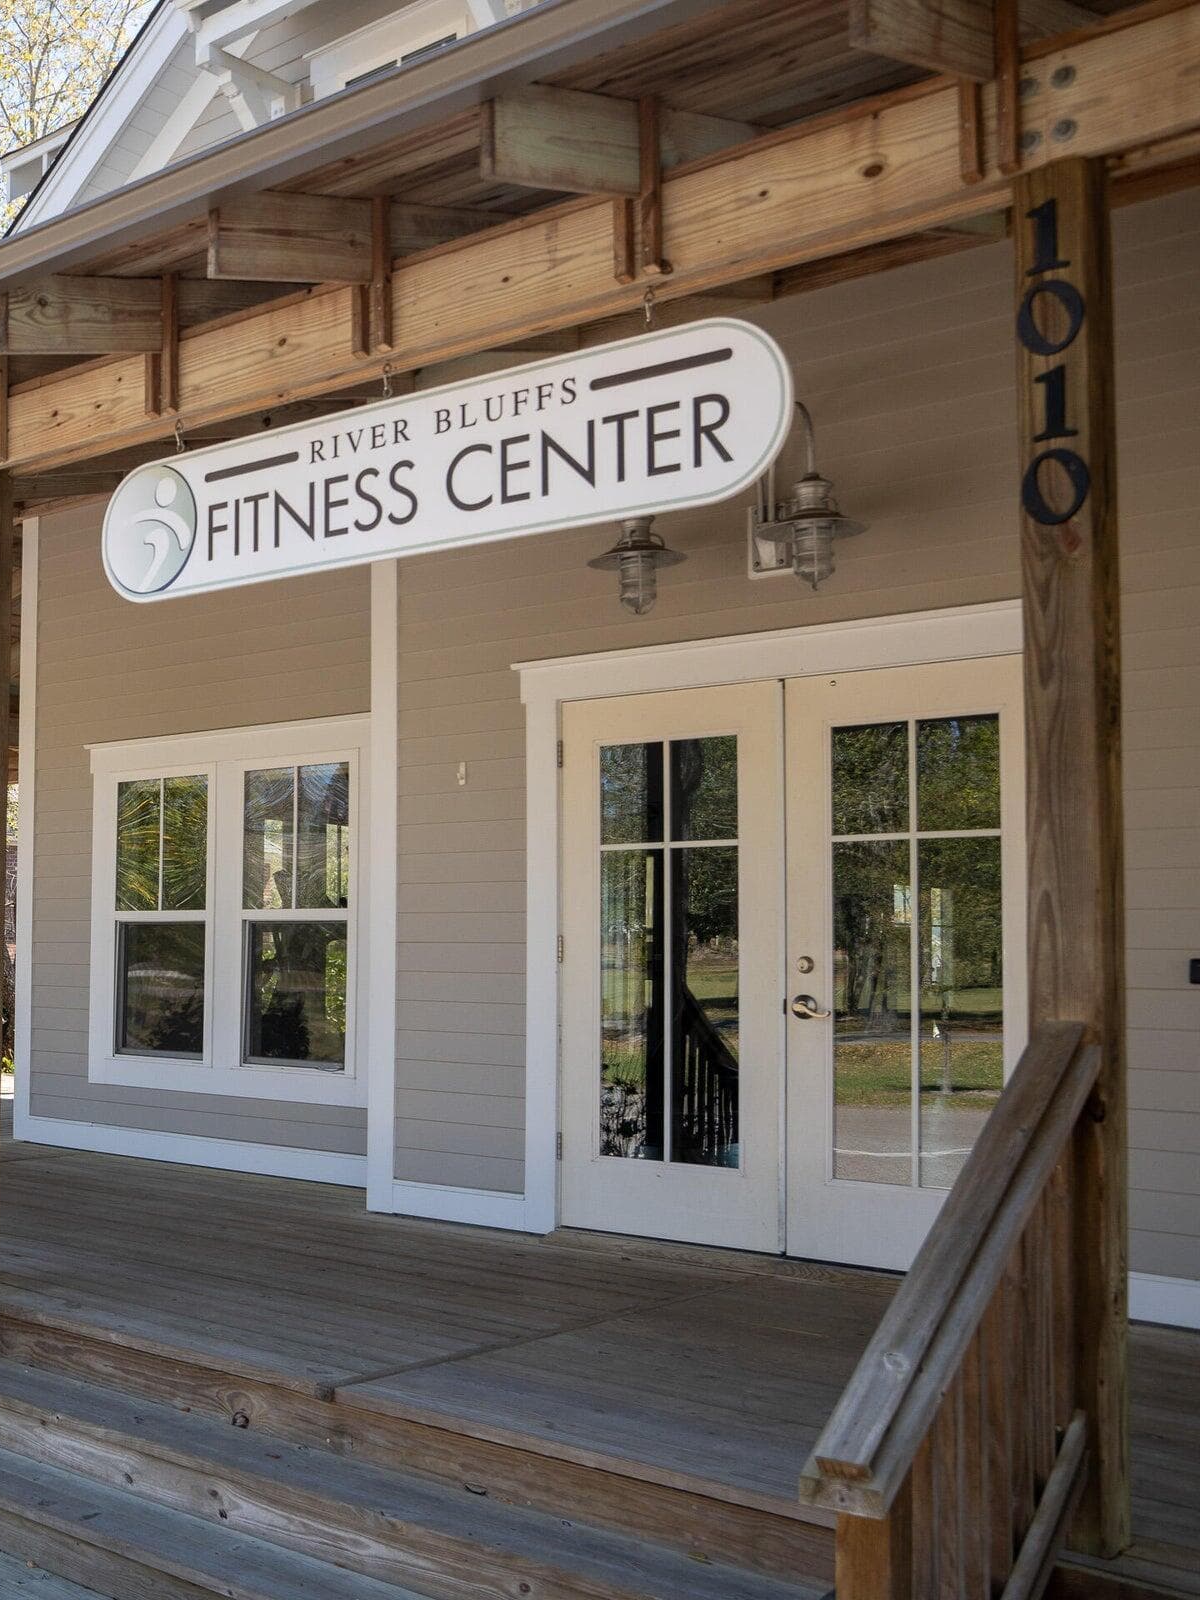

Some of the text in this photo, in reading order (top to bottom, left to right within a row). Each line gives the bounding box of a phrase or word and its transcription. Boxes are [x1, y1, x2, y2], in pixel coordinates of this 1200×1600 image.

[309, 376, 578, 464] RIVER BLUFFS
[1016, 197, 1091, 526] 1010
[207, 392, 734, 562] FITNESS CENTER
